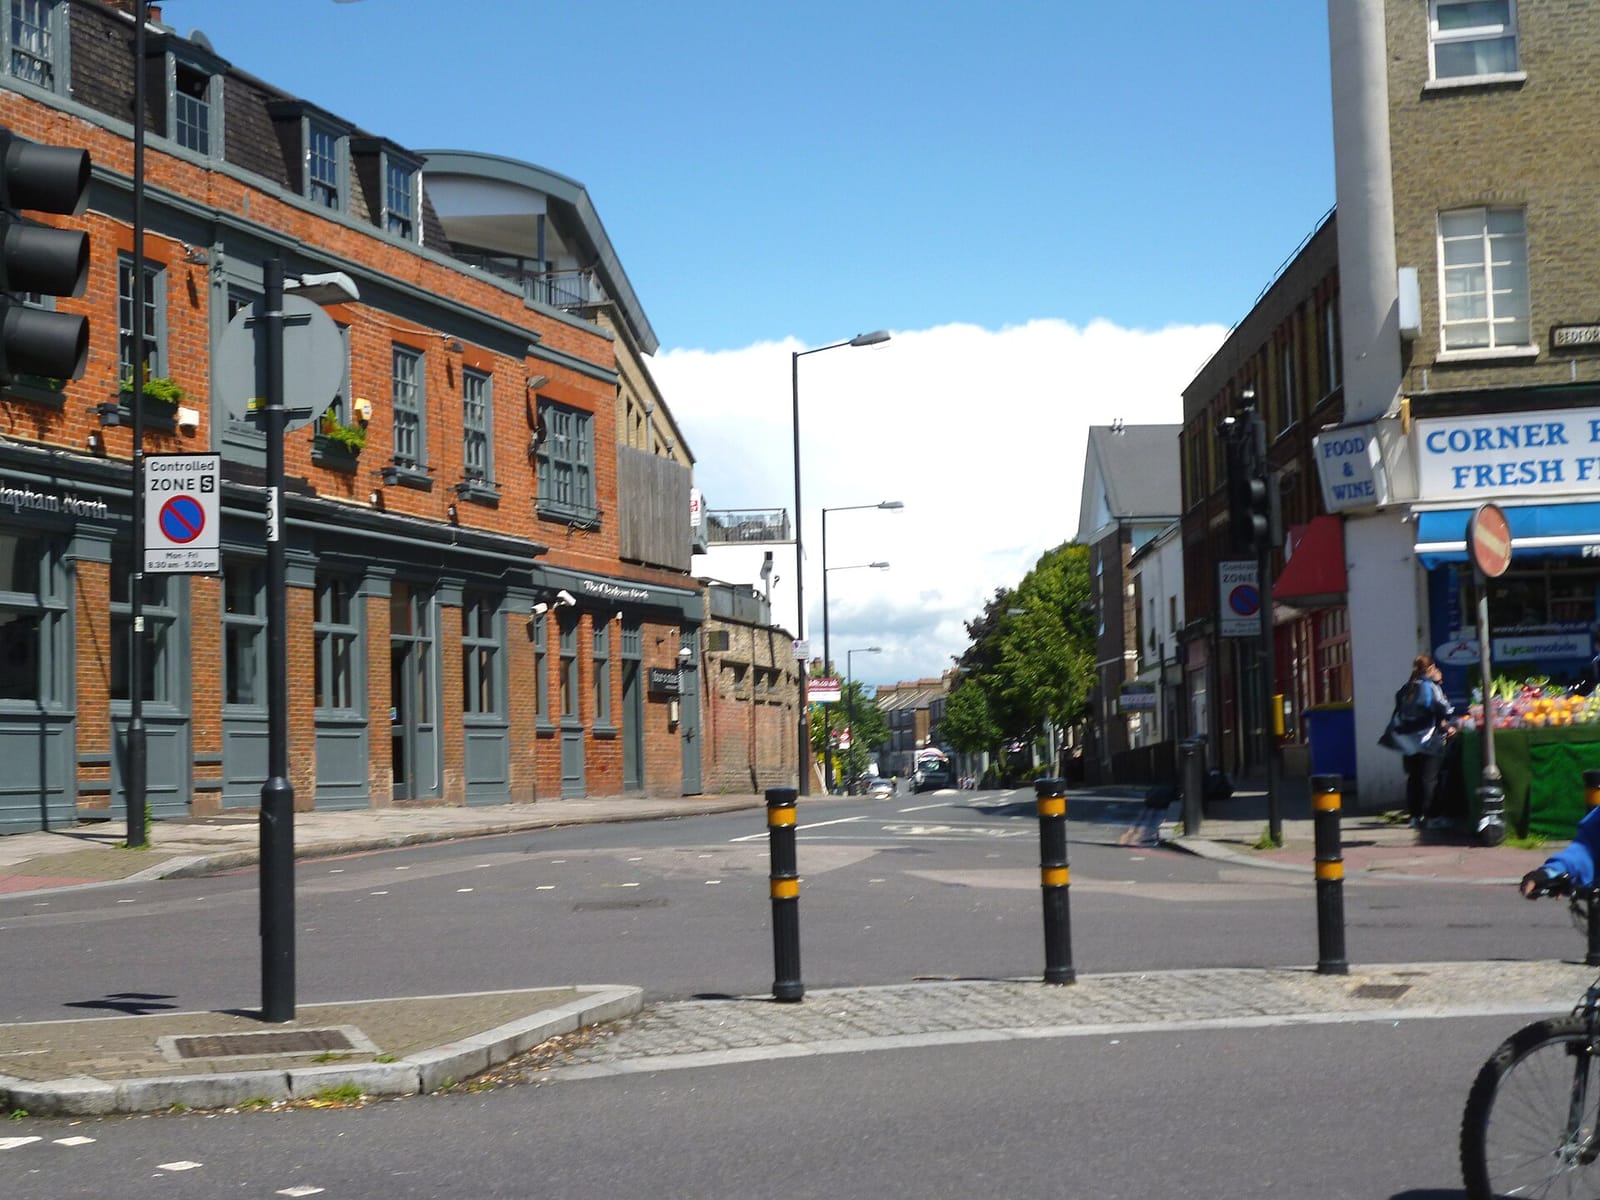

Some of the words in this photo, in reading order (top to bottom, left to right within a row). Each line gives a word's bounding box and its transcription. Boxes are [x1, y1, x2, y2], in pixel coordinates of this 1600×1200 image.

[1426, 421, 1568, 454] CORNER
[1324, 437, 1365, 458] FOOD
[150, 460, 215, 472] Controlled
[1342, 462, 1354, 477] &
[1451, 459, 1565, 489] FRESH
[151, 478, 195, 491] ZONE
[201, 476, 213, 492] S
[1331, 480, 1375, 501] WINE
[63, 491, 108, 520] North
[187, 551, 198, 559] Fri
[147, 561, 167, 569] 8.30
[184, 560, 203, 568] 5.30
[204, 561, 216, 570] pm
[1223, 573, 1254, 583] ZONE
